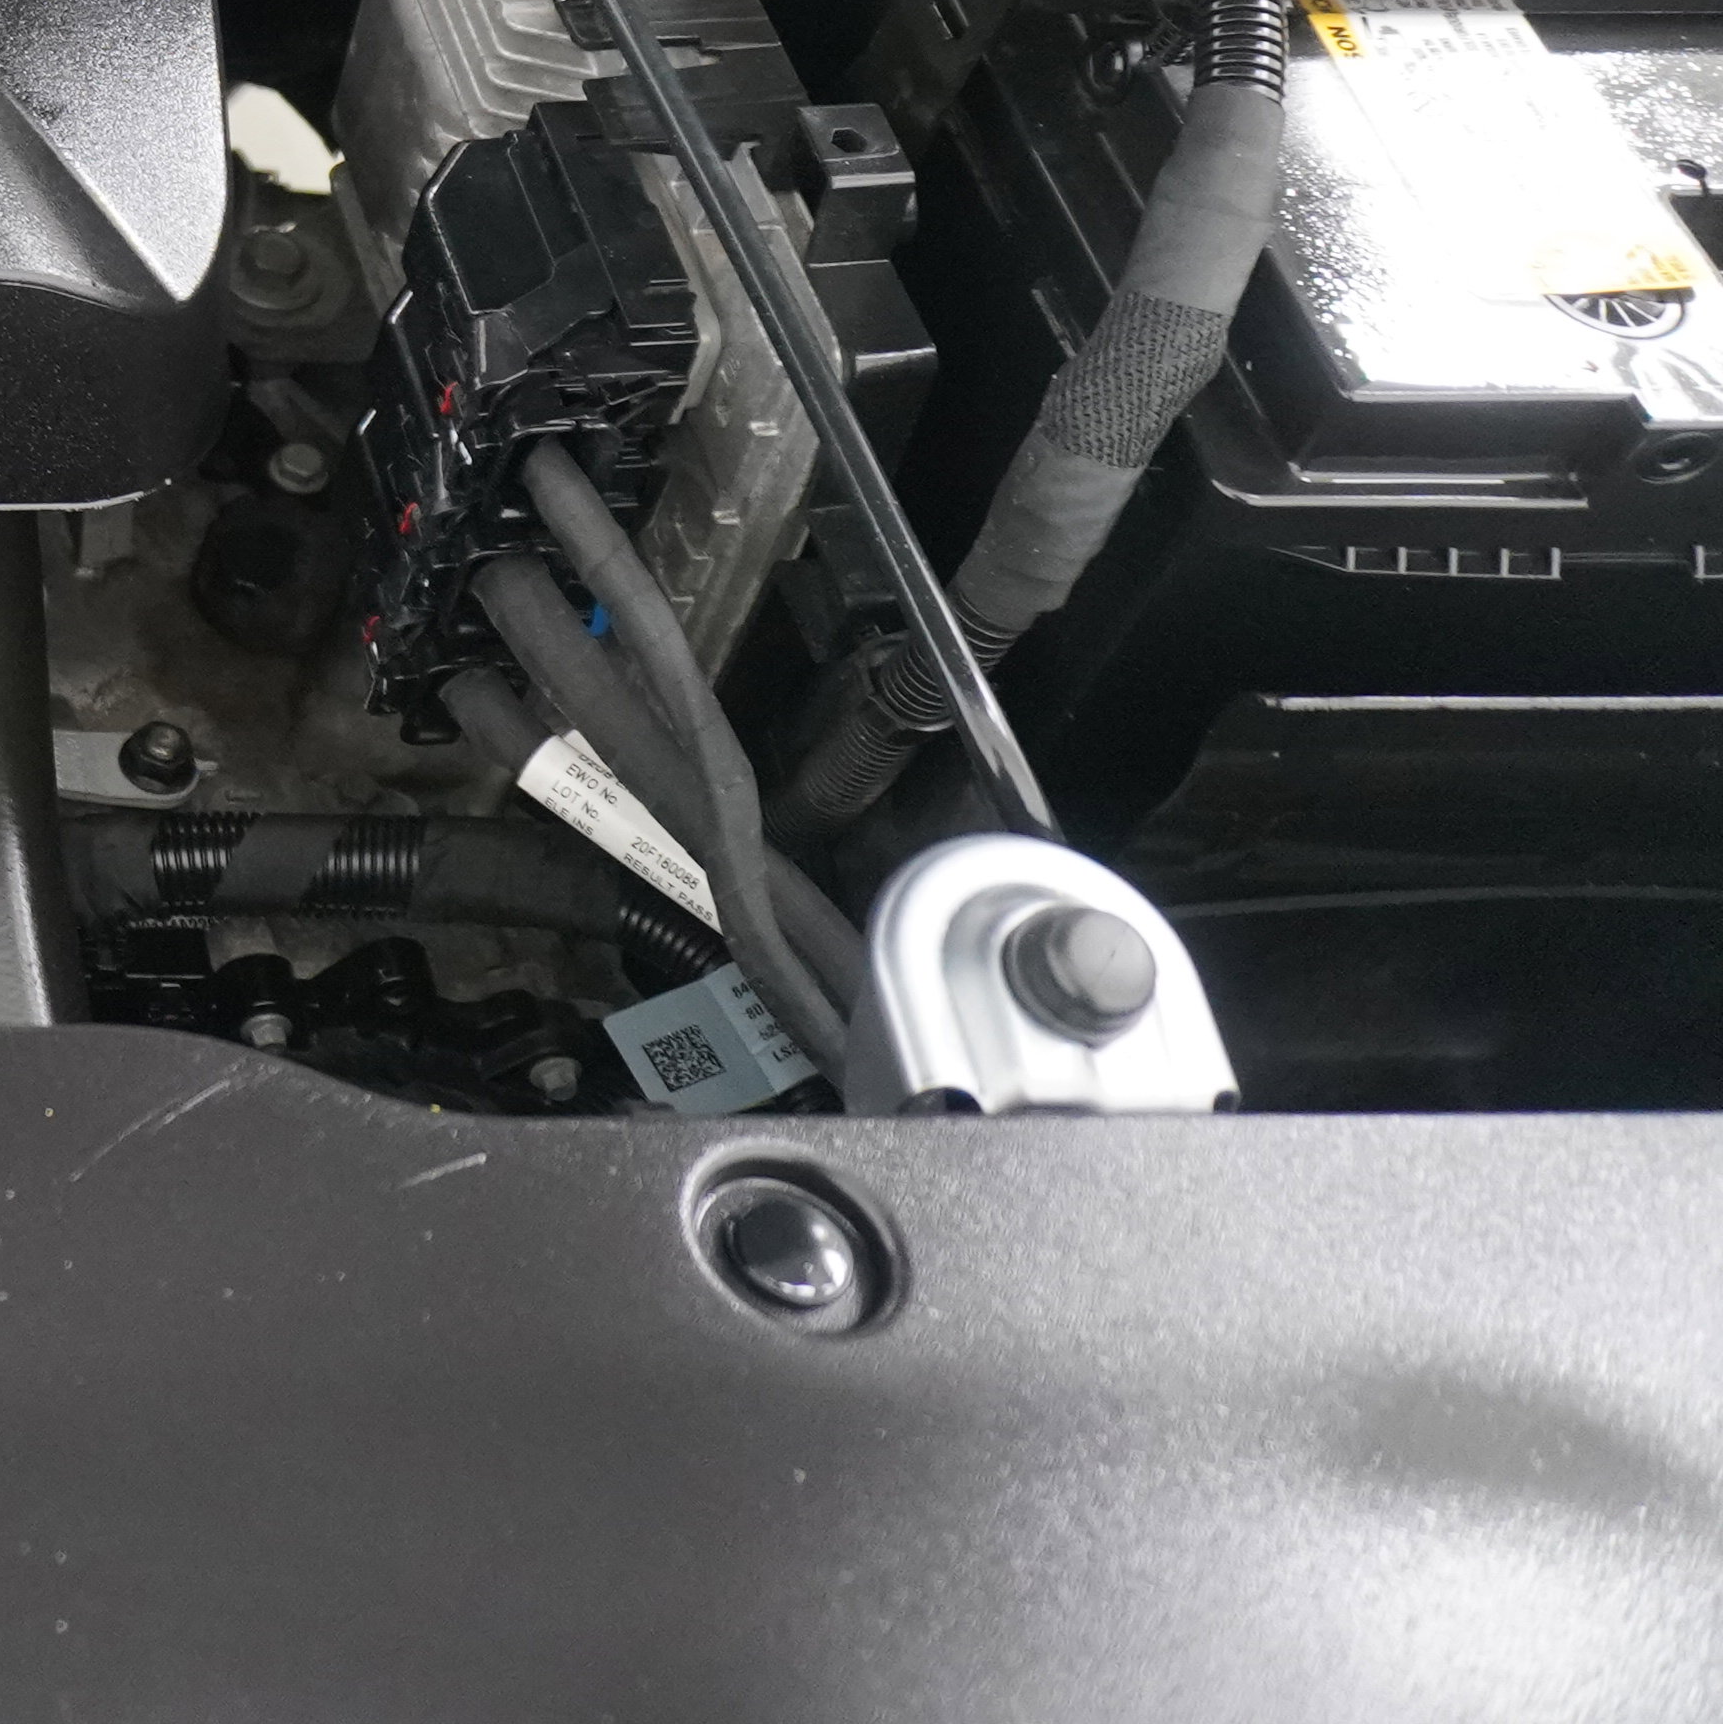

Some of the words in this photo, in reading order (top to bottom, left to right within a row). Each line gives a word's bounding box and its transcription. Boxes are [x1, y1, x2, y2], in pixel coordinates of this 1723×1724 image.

[552, 780, 582, 804] LOT
[581, 799, 601, 822] No.
[565, 763, 599, 790] EWO
[601, 787, 619, 809] No.
[544, 796, 570, 820] ELE
[572, 817, 594, 837] INS
[623, 852, 677, 893] RESULT
[677, 890, 714, 923] PASS
